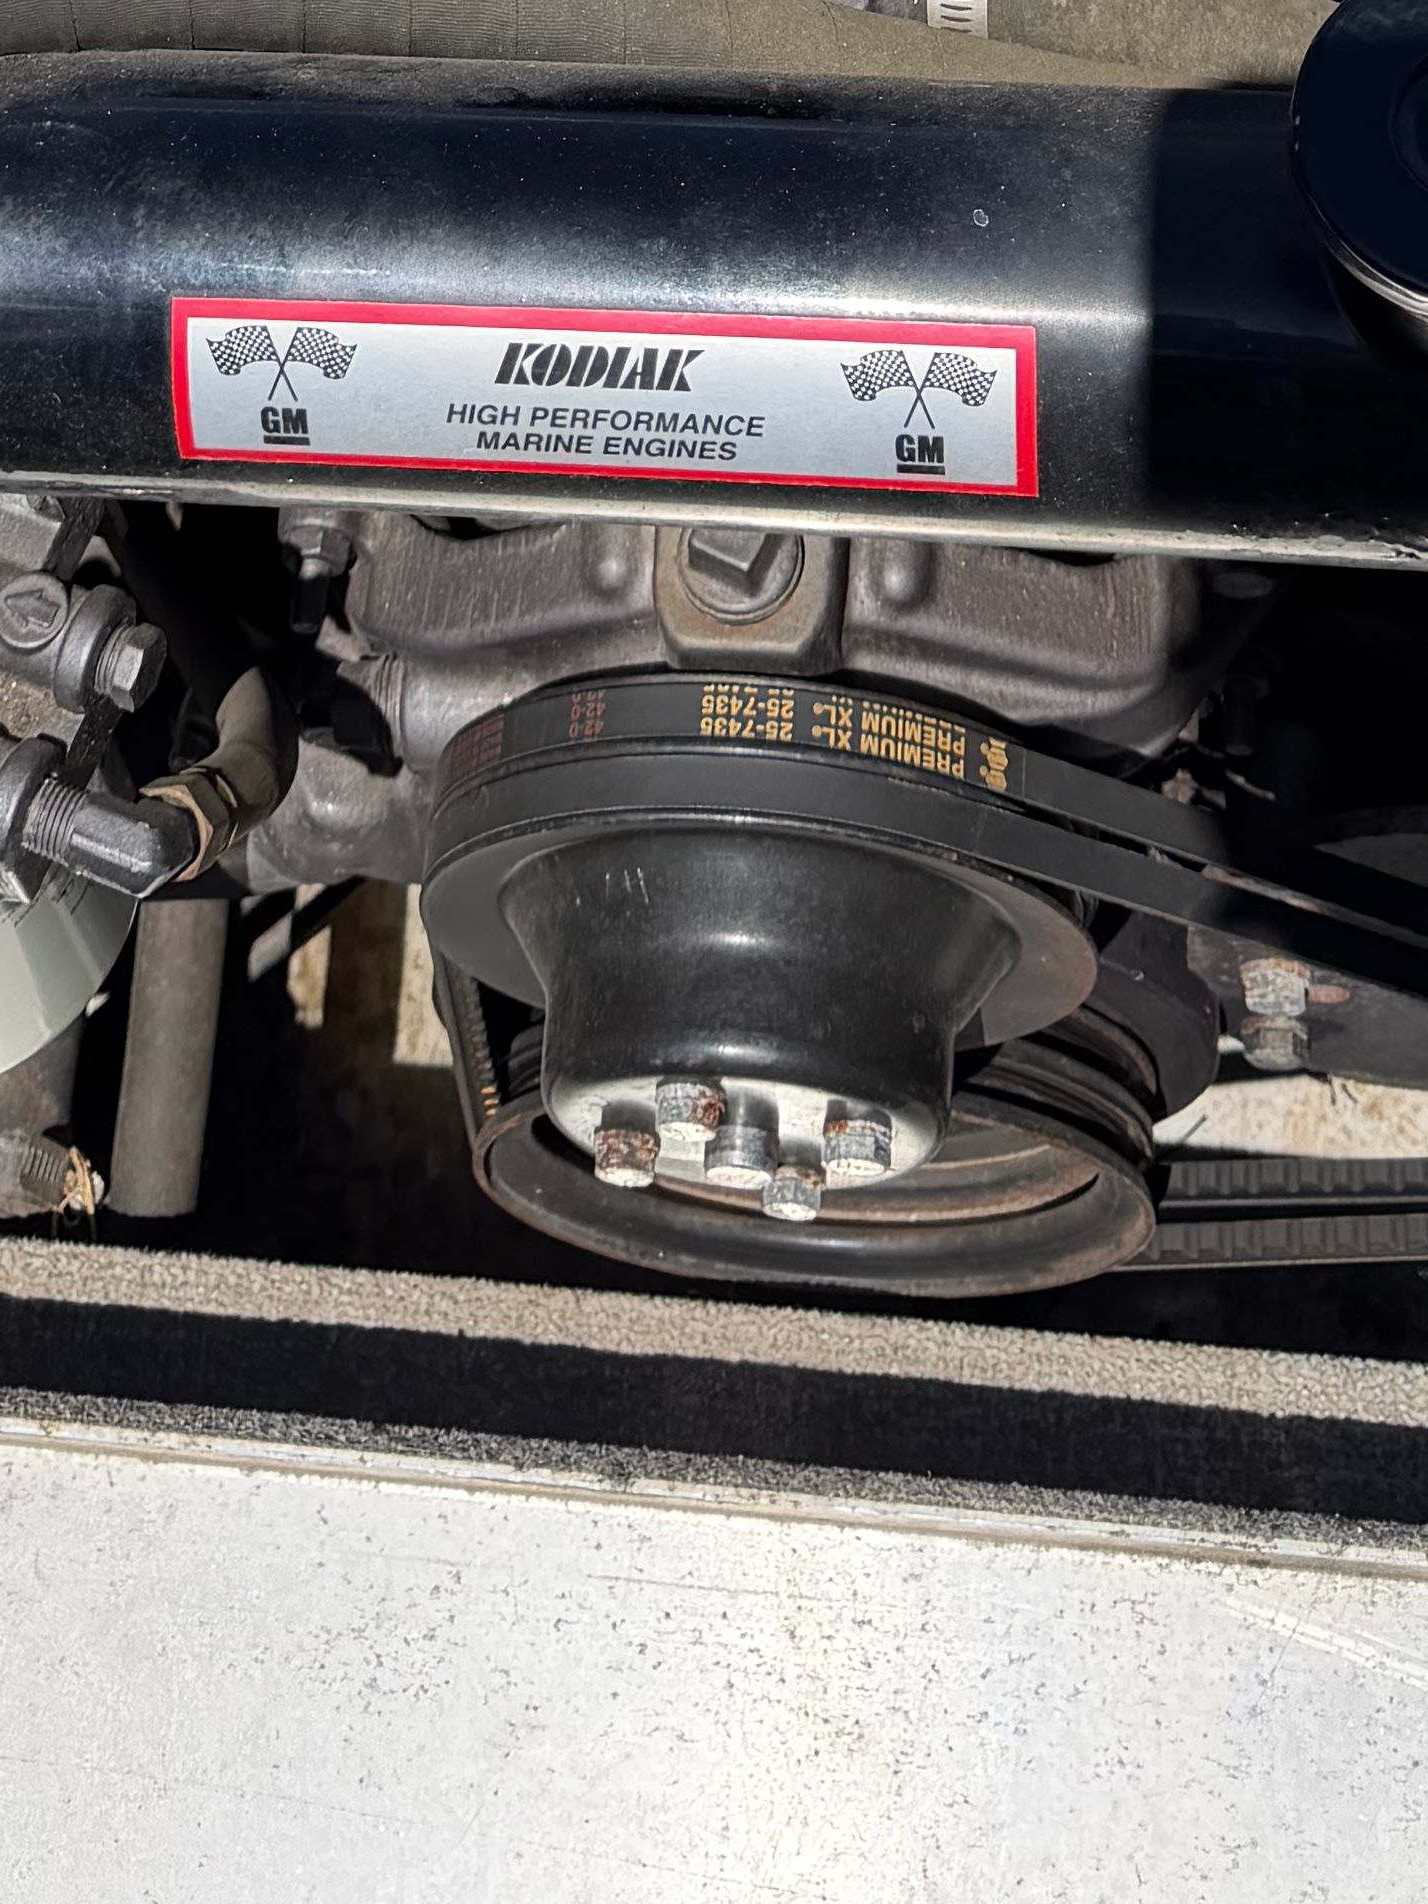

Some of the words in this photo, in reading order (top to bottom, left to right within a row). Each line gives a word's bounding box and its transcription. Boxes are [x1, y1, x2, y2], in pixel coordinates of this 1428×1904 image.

[492, 341, 706, 394] KODIAK
[260, 406, 311, 437] GM
[445, 401, 526, 429] HIGH
[530, 406, 766, 440] PERFORMANCE
[475, 428, 598, 456] MARINE
[601, 433, 739, 462] ENGINES
[894, 435, 946, 465] GM
[701, 695, 795, 719] 25-7435
[699, 717, 794, 742] 25-7435
[861, 710, 966, 757] PREMIUM
[860, 732, 965, 780] PREMIUM
